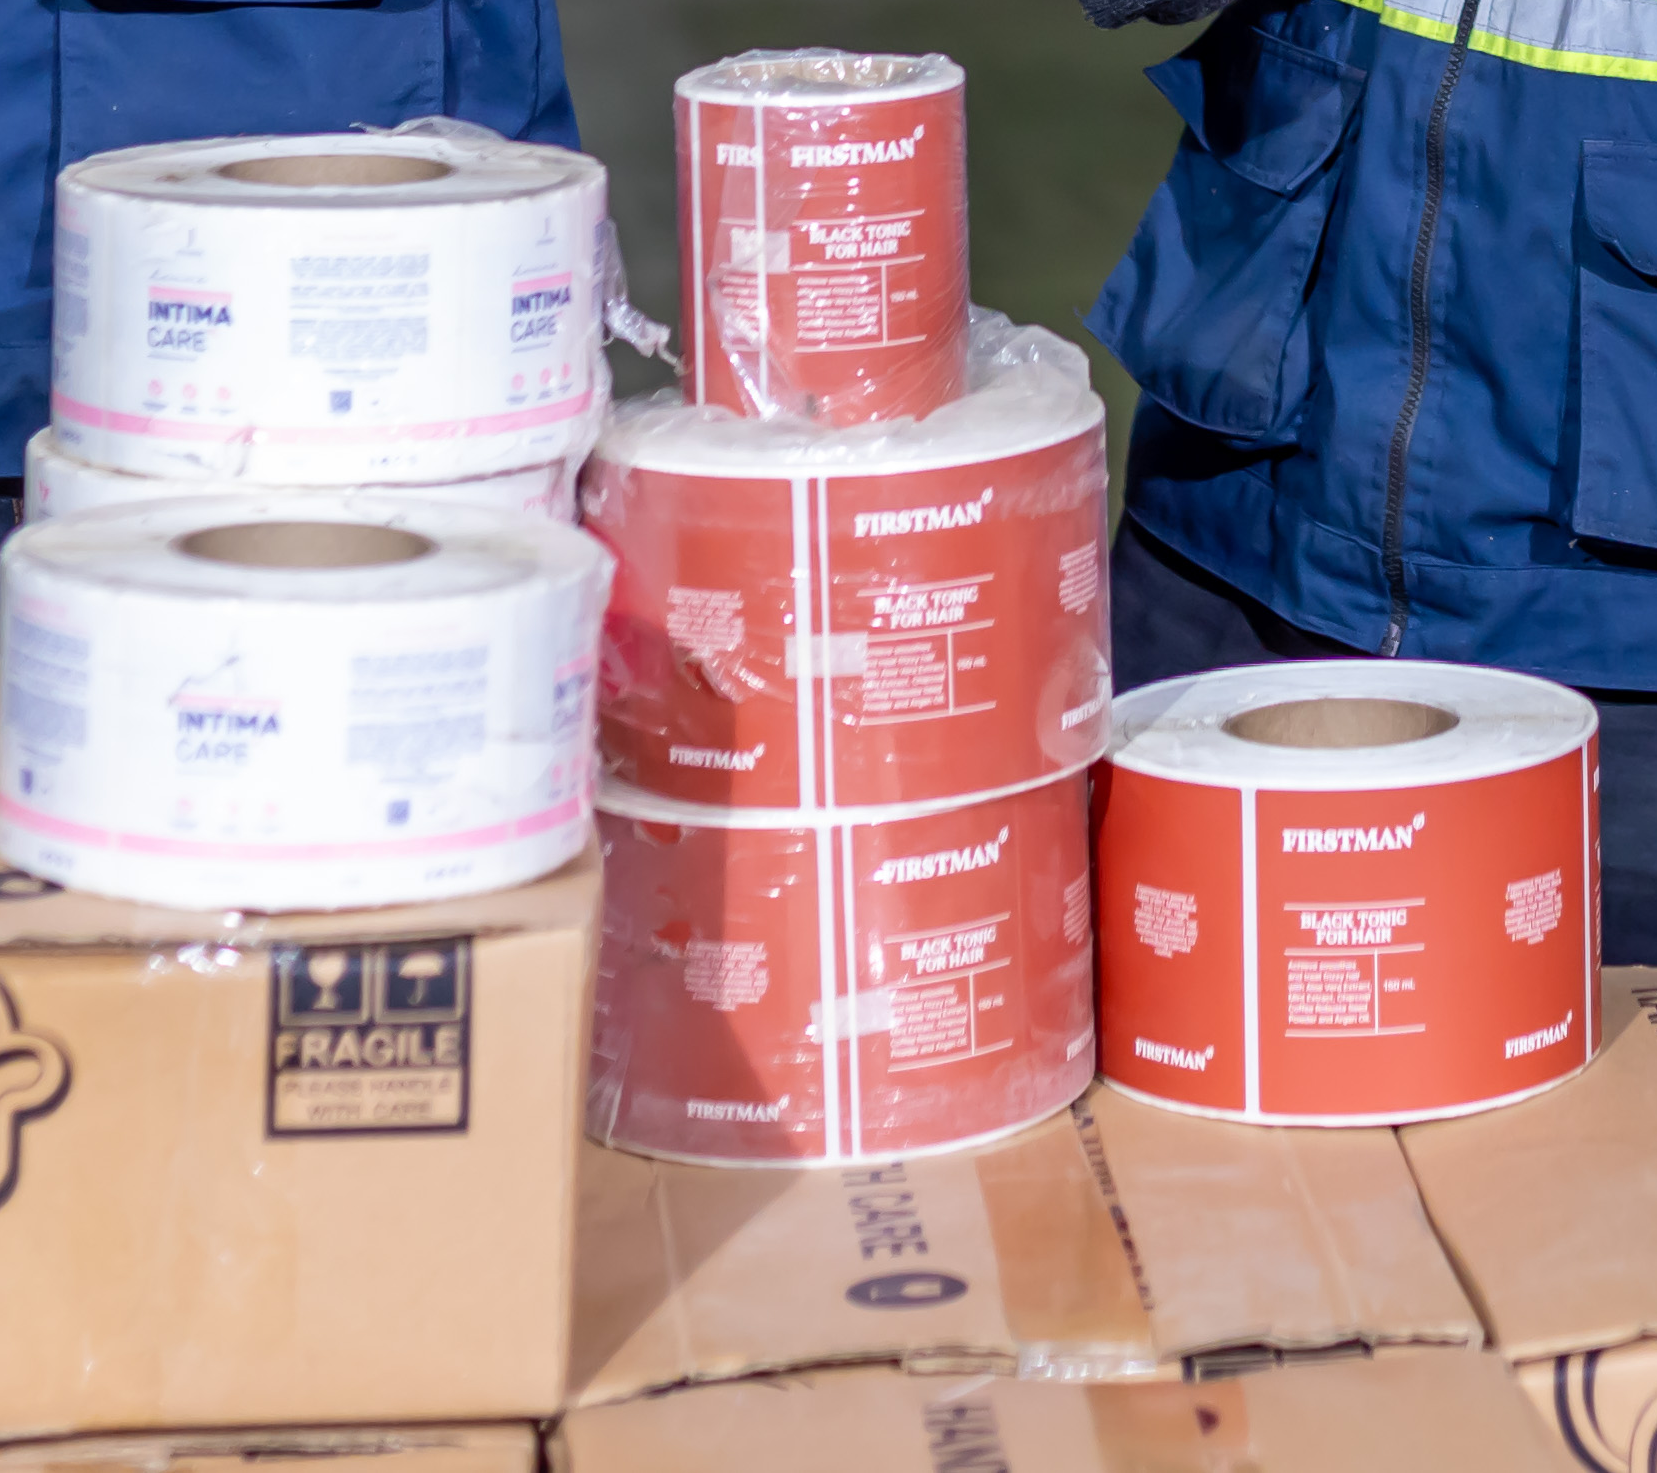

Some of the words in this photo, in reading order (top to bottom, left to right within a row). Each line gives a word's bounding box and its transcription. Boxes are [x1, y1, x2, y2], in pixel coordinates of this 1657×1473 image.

[790, 137, 915, 168] FIRSTMAN
[809, 225, 863, 245] BLACK
[866, 220, 912, 238] TONIC
[824, 243, 857, 260] FOR
[859, 239, 899, 257] HAIR
[147, 301, 233, 327] INTIMA
[511, 285, 572, 317] INTIMA
[146, 327, 206, 353] CARE
[509, 313, 557, 344] CARE
[854, 502, 982, 538] FIRSTMAN
[874, 593, 928, 616] BLACK
[931, 584, 979, 606] TONIC
[890, 609, 923, 630] FOR
[926, 605, 966, 625] HAIR
[176, 710, 282, 736] INTIMA
[175, 740, 248, 764] CARE
[668, 744, 756, 771] FIRSTMAN
[1282, 824, 1413, 853] FIRSTMAN
[881, 840, 1000, 885] FIRSTMAN
[1300, 911, 1355, 931] BLACK
[1357, 908, 1408, 928] TONIC
[901, 935, 952, 962] BLACK
[954, 923, 997, 951] TONIC
[1315, 928, 1349, 946] FOR
[1351, 926, 1392, 945] HAIR
[916, 955, 946, 975] FOR
[949, 946, 985, 969] HAIR
[275, 1022, 462, 1070] FRAGILE
[1134, 1035, 1206, 1072] FIRSTMAN
[1504, 1021, 1568, 1060] FIRSTMAN
[686, 1100, 780, 1123] FIRSTMAN
[847, 1191, 929, 1261] CARE
